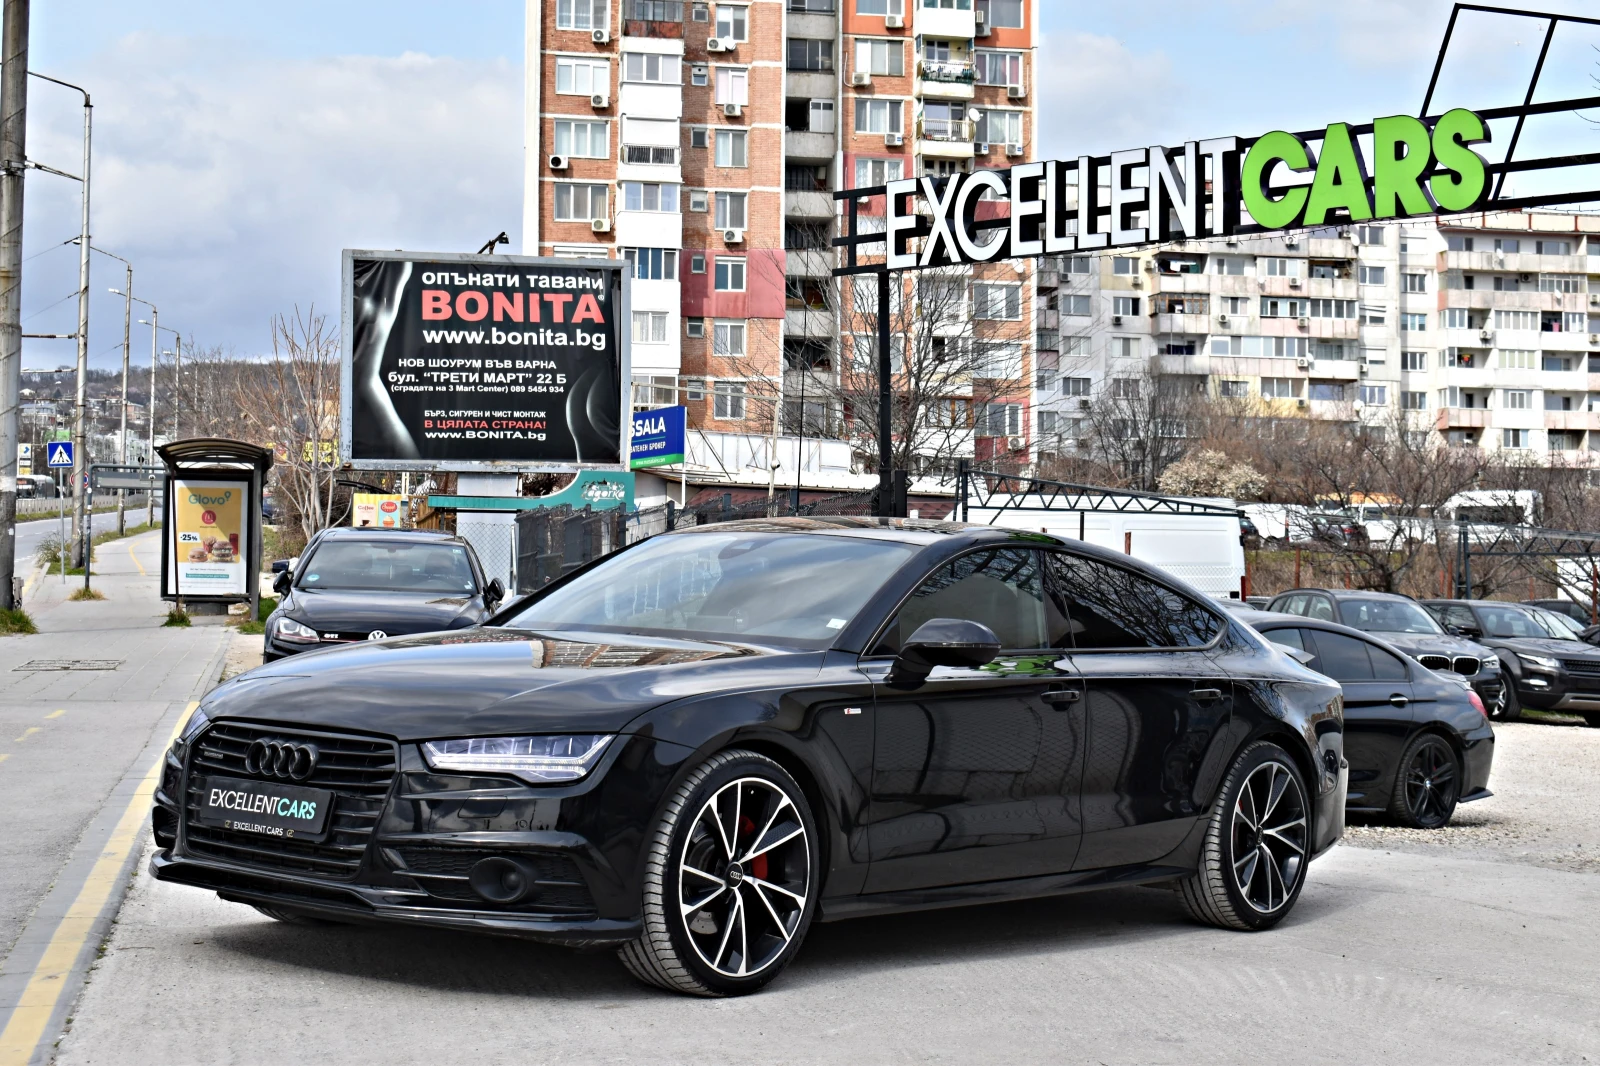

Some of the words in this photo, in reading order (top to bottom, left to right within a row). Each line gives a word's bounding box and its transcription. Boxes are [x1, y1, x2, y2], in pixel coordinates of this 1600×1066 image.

[421, 271, 520, 288] опънати
[526, 274, 604, 290] тавани
[421, 289, 606, 324] BONITA
[422, 327, 606, 351] www.bonita.bg
[398, 358, 426, 368] НОВ
[428, 359, 482, 369] ШОУРУМ
[485, 359, 512, 369] ВЪВ
[515, 360, 557, 370] ВАРНА
[388, 371, 419, 384] бул.
[536, 373, 553, 384] 22
[556, 373, 567, 384] Б
[391, 384, 434, 393] (сградата
[476, 385, 509, 394] Center)
[510, 385, 526, 393] 089
[527, 385, 548, 393] 5454
[549, 385, 564, 393] 934
[449, 410, 483, 418] СИГУРЕН
[484, 410, 490, 418] И
[492, 410, 512, 418] ЧИСТ
[513, 410, 546, 418] МОНТАЖ
[424, 420, 433, 429] В
[437, 420, 489, 430] ЦЯЛАТА
[491, 420, 547, 429] СТРАНА!
[424, 430, 547, 441] www.BONITA.bg
[188, 493, 226, 505] Glovo
[180, 533, 198, 542] -25%
[233, 821, 267, 833] EXCELLENT
[266, 826, 284, 836] CARS
